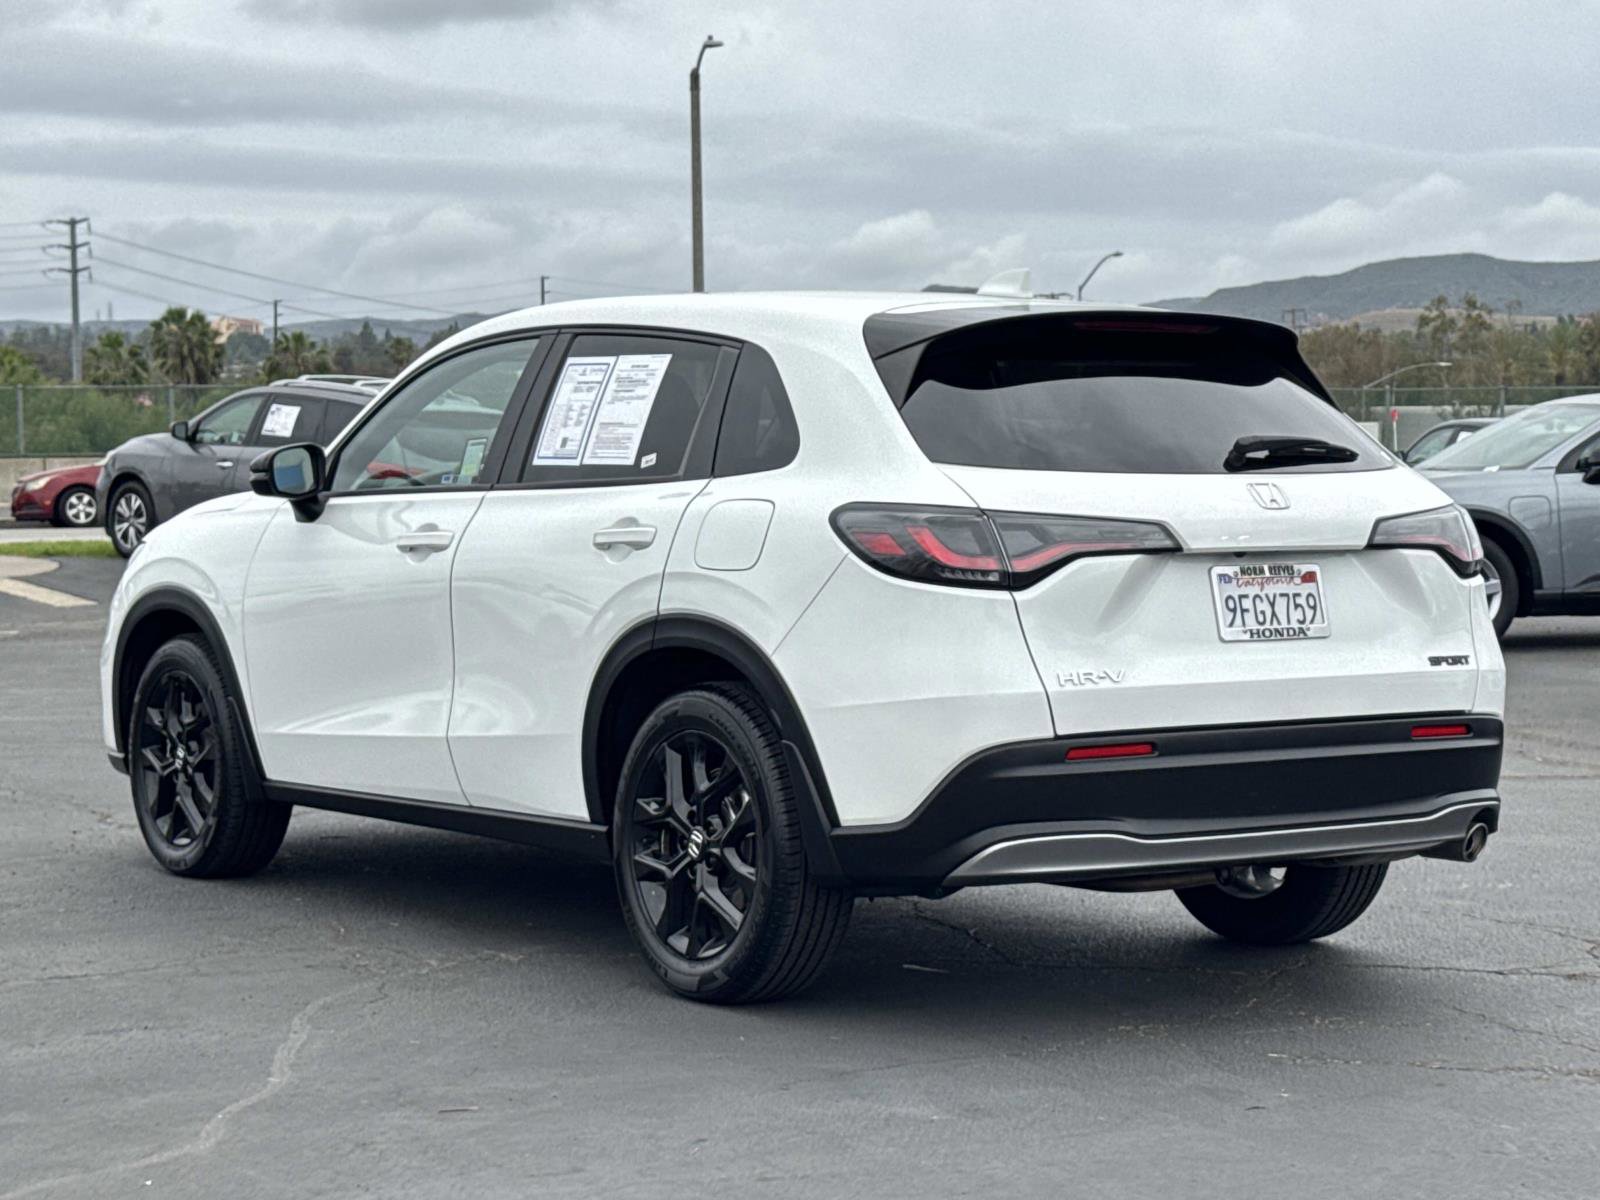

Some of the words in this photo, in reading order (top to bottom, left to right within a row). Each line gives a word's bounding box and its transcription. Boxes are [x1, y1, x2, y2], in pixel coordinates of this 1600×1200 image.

[1240, 566, 1266, 576] NORM
[1268, 565, 1295, 576] REEVES
[1224, 592, 1317, 628] 9FGX759
[1249, 626, 1308, 639] HONDA
[1427, 655, 1470, 666] SPORT
[1056, 668, 1125, 688] HR-V
